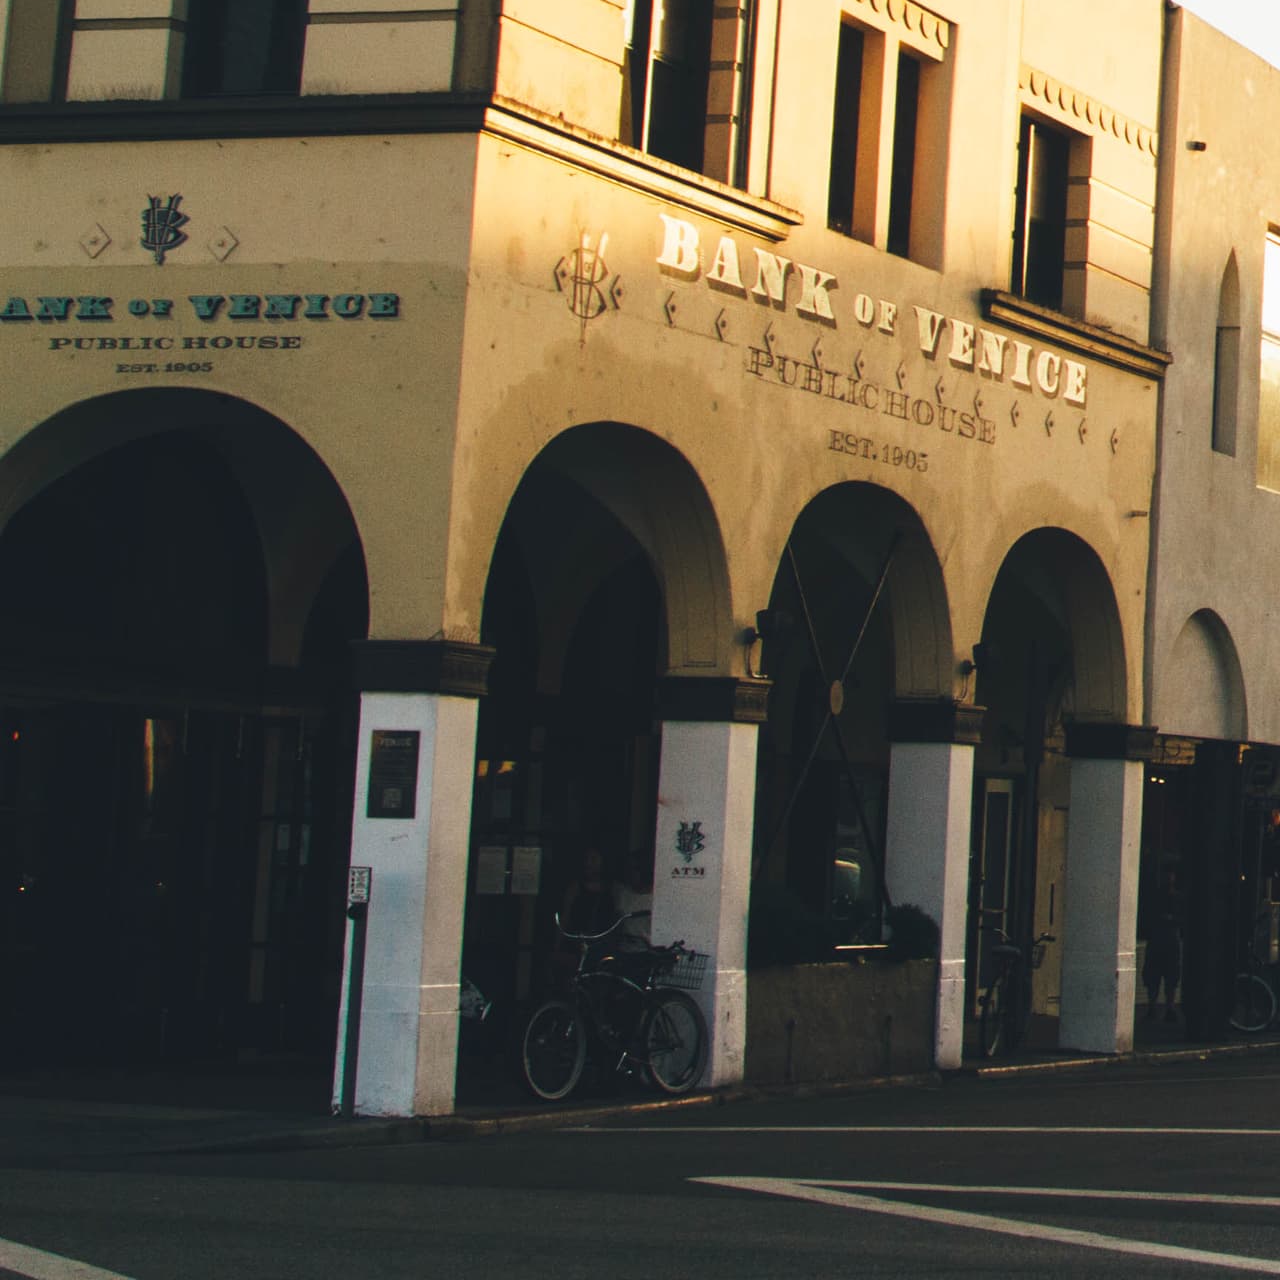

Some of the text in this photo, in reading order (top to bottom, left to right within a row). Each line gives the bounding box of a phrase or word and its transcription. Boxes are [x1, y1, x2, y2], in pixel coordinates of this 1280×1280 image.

[0, 293, 400, 321] ANK OF VENICE
[656, 213, 838, 326] BANK
[854, 293, 898, 334] OF
[913, 305, 1089, 405] VENICE
[49, 336, 301, 350] PUBLIC HOUSE
[116, 361, 214, 374] EST. 1905
[746, 345, 996, 446] PUBLIC HOUSE
[828, 428, 929, 473] EST. 1905
[671, 867, 705, 876] ATM
